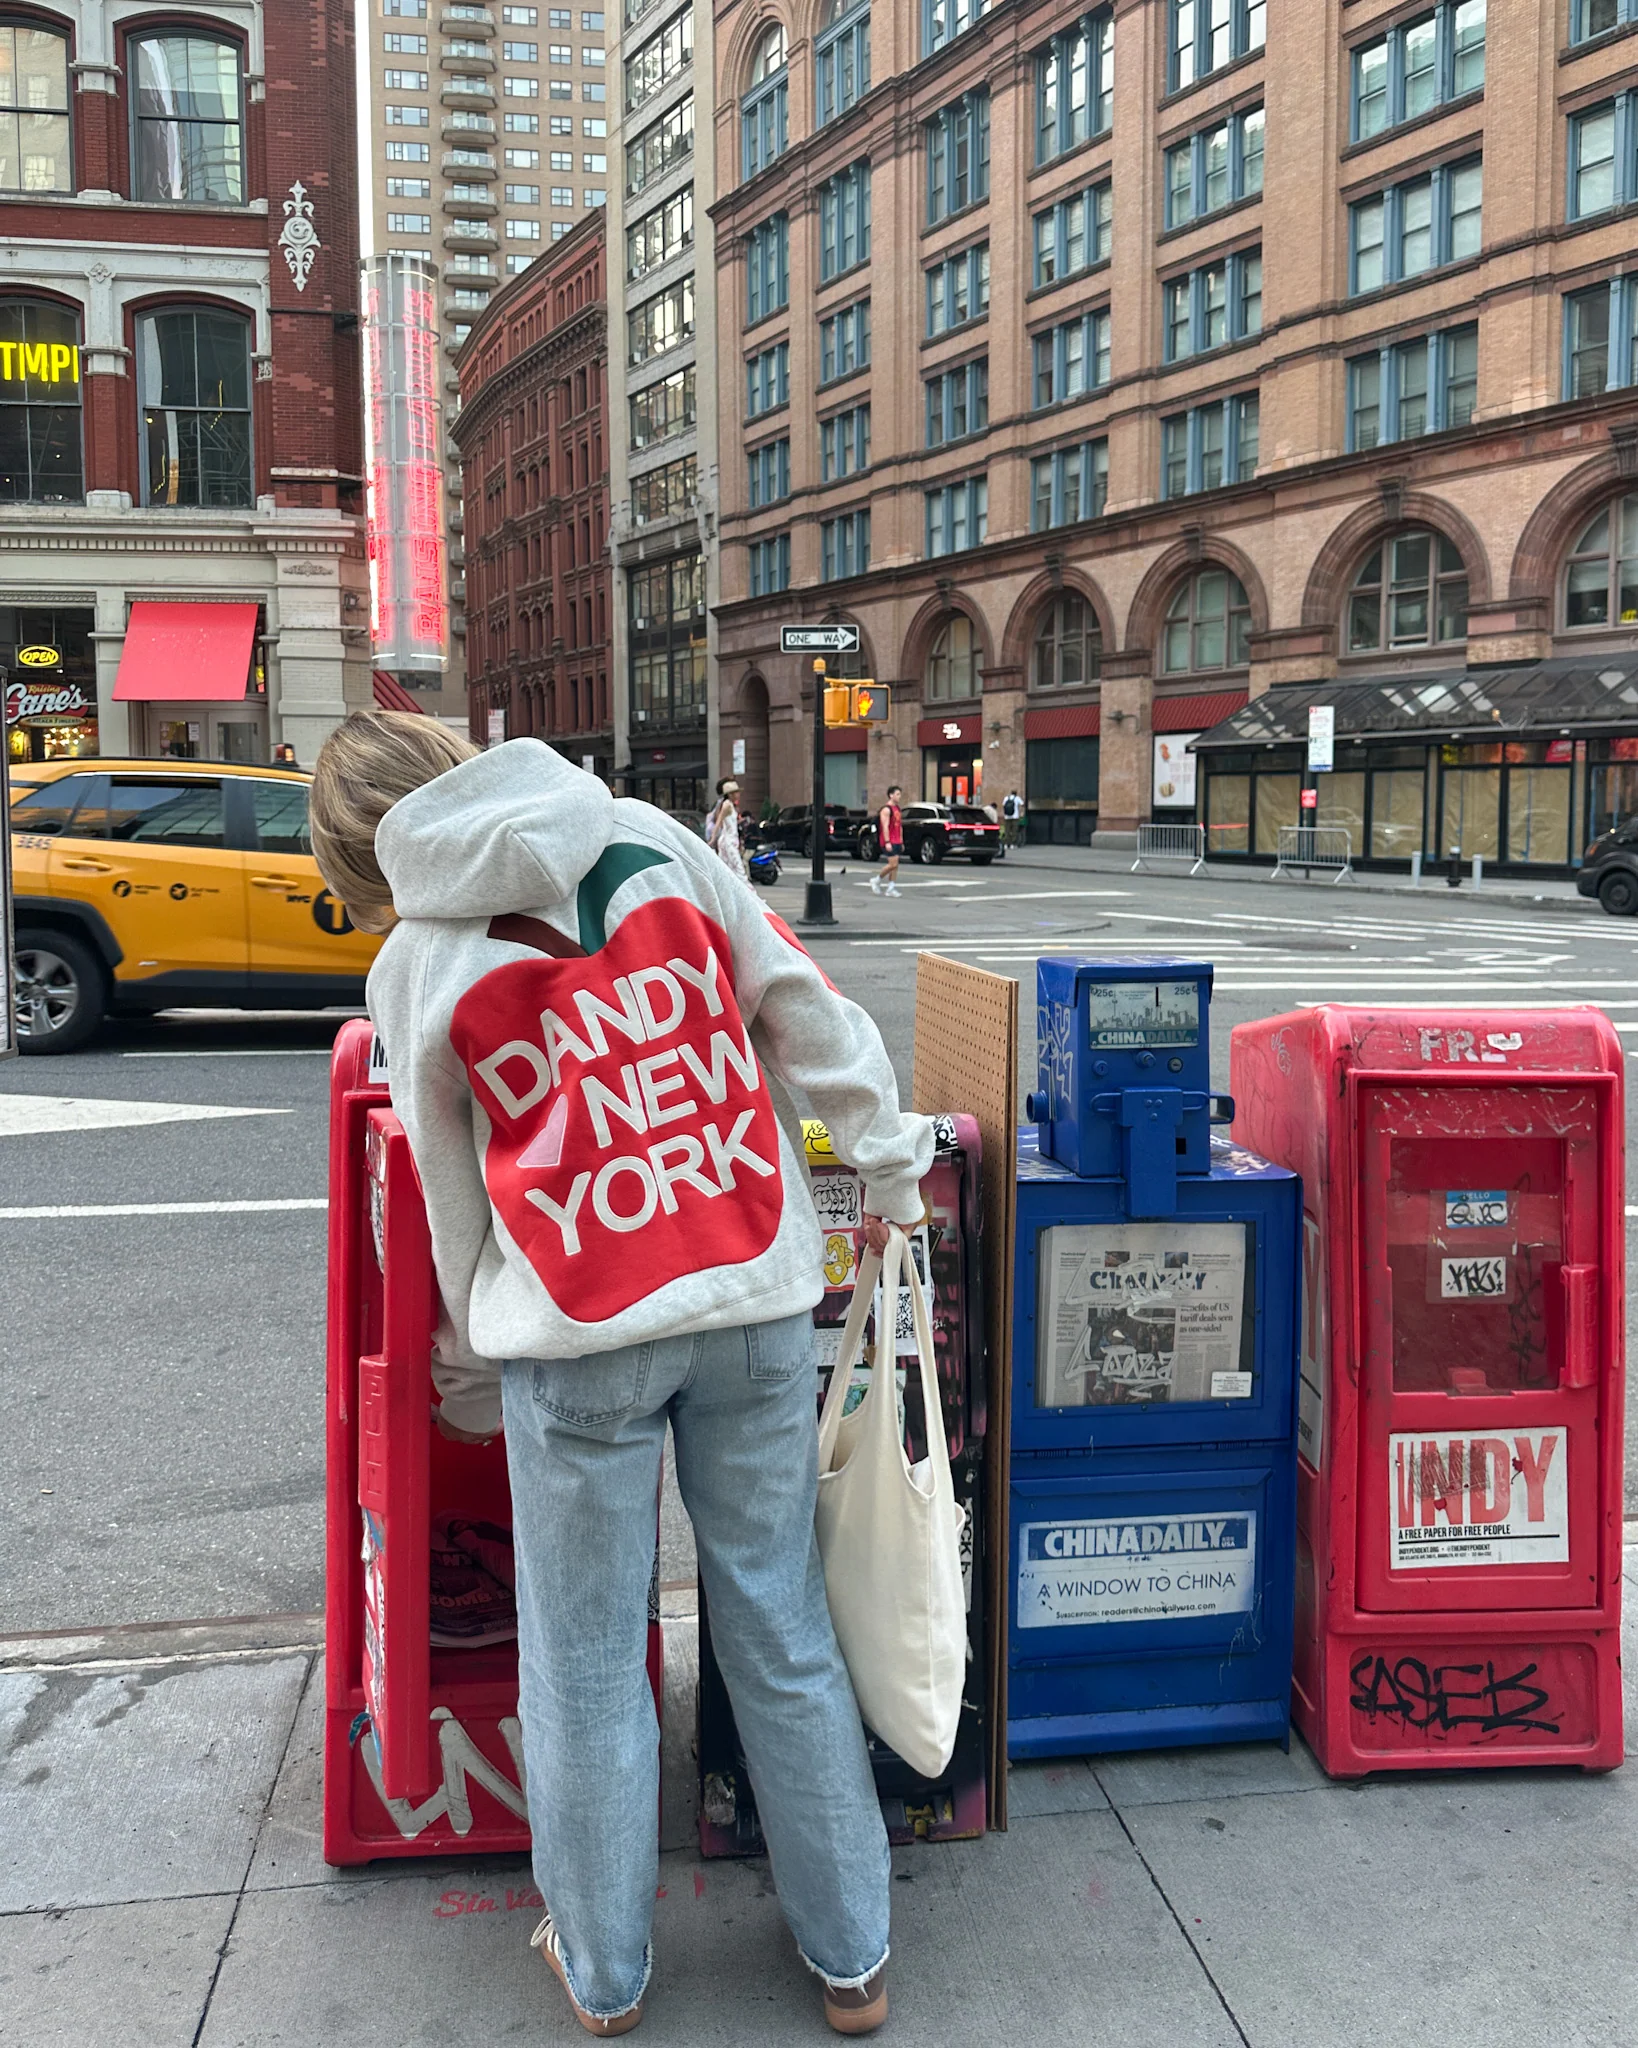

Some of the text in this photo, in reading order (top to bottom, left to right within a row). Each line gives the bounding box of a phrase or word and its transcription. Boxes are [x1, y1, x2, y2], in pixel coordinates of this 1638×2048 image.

[788, 634, 848, 644] ONE WAY
[23, 651, 55, 662] OPEN
[7, 682, 88, 724] Cane's
[473, 945, 724, 1120] DANDY
[579, 1022, 760, 1149] NEW
[524, 1108, 777, 1257] YORK
[1180, 1312, 1233, 1322] tariff deals seen
[1218, 1302, 1230, 1311] US
[1187, 1323, 1222, 1333] one-sided
[1396, 1435, 1559, 1528] INDY
[1398, 1524, 1511, 1540] A FREE PAPER FOR FREE PEOPLE
[1037, 1571, 1237, 1599] A WINDOW TO CHINA
[433, 1889, 498, 1918] Sin
